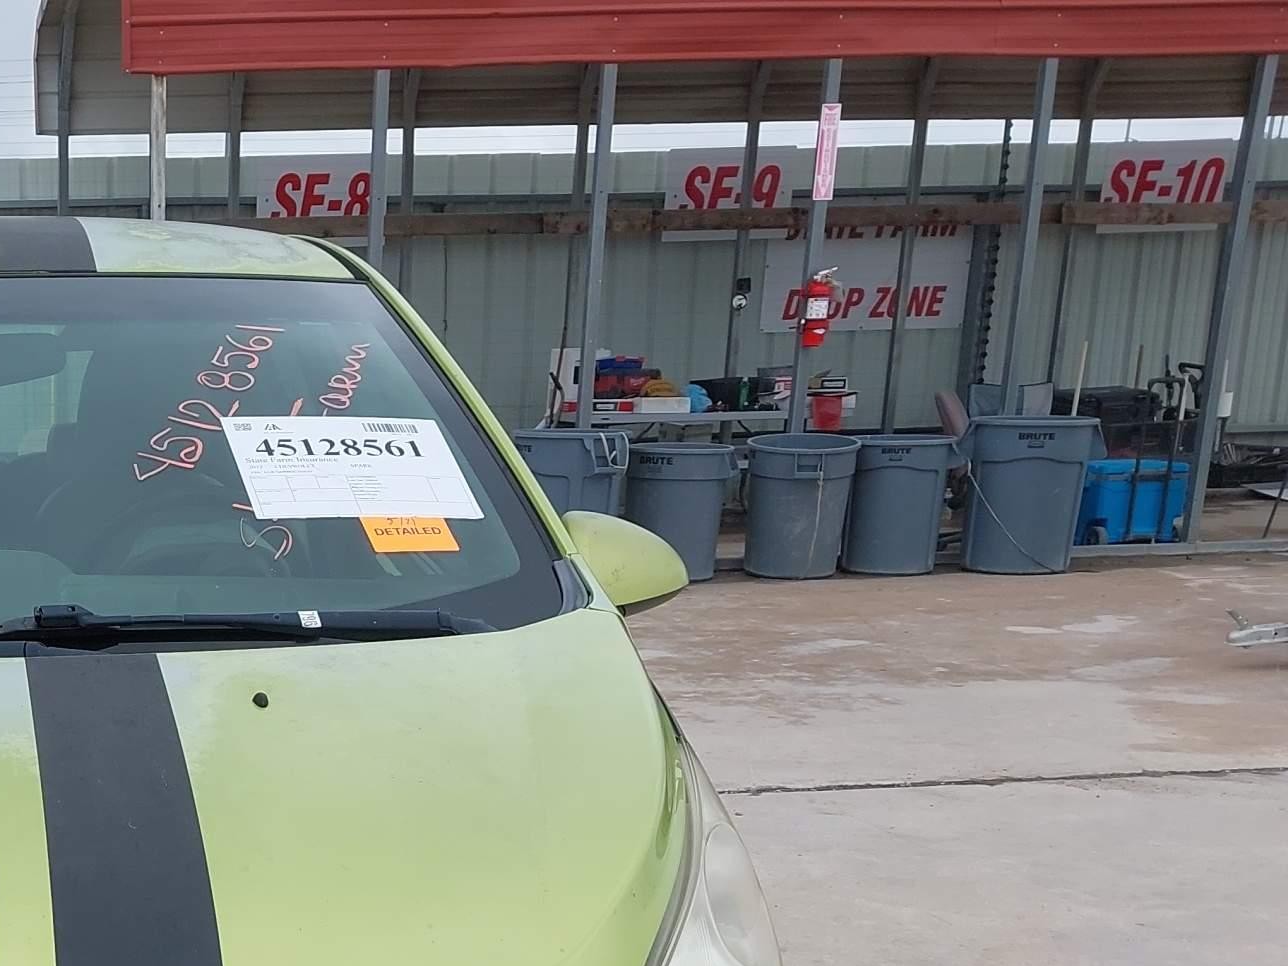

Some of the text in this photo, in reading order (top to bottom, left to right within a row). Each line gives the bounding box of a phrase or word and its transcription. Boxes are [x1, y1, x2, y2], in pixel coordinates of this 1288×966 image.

[679, 165, 781, 209] SF-9
[1104, 157, 1225, 203] SF-10
[271, 172, 371, 217] SF-8
[782, 287, 865, 321] DP
[255, 437, 425, 458] 45128561
[1018, 432, 1056, 441] BRUTE
[639, 456, 674, 466] BRUTE
[374, 526, 442, 537] DETAILED
